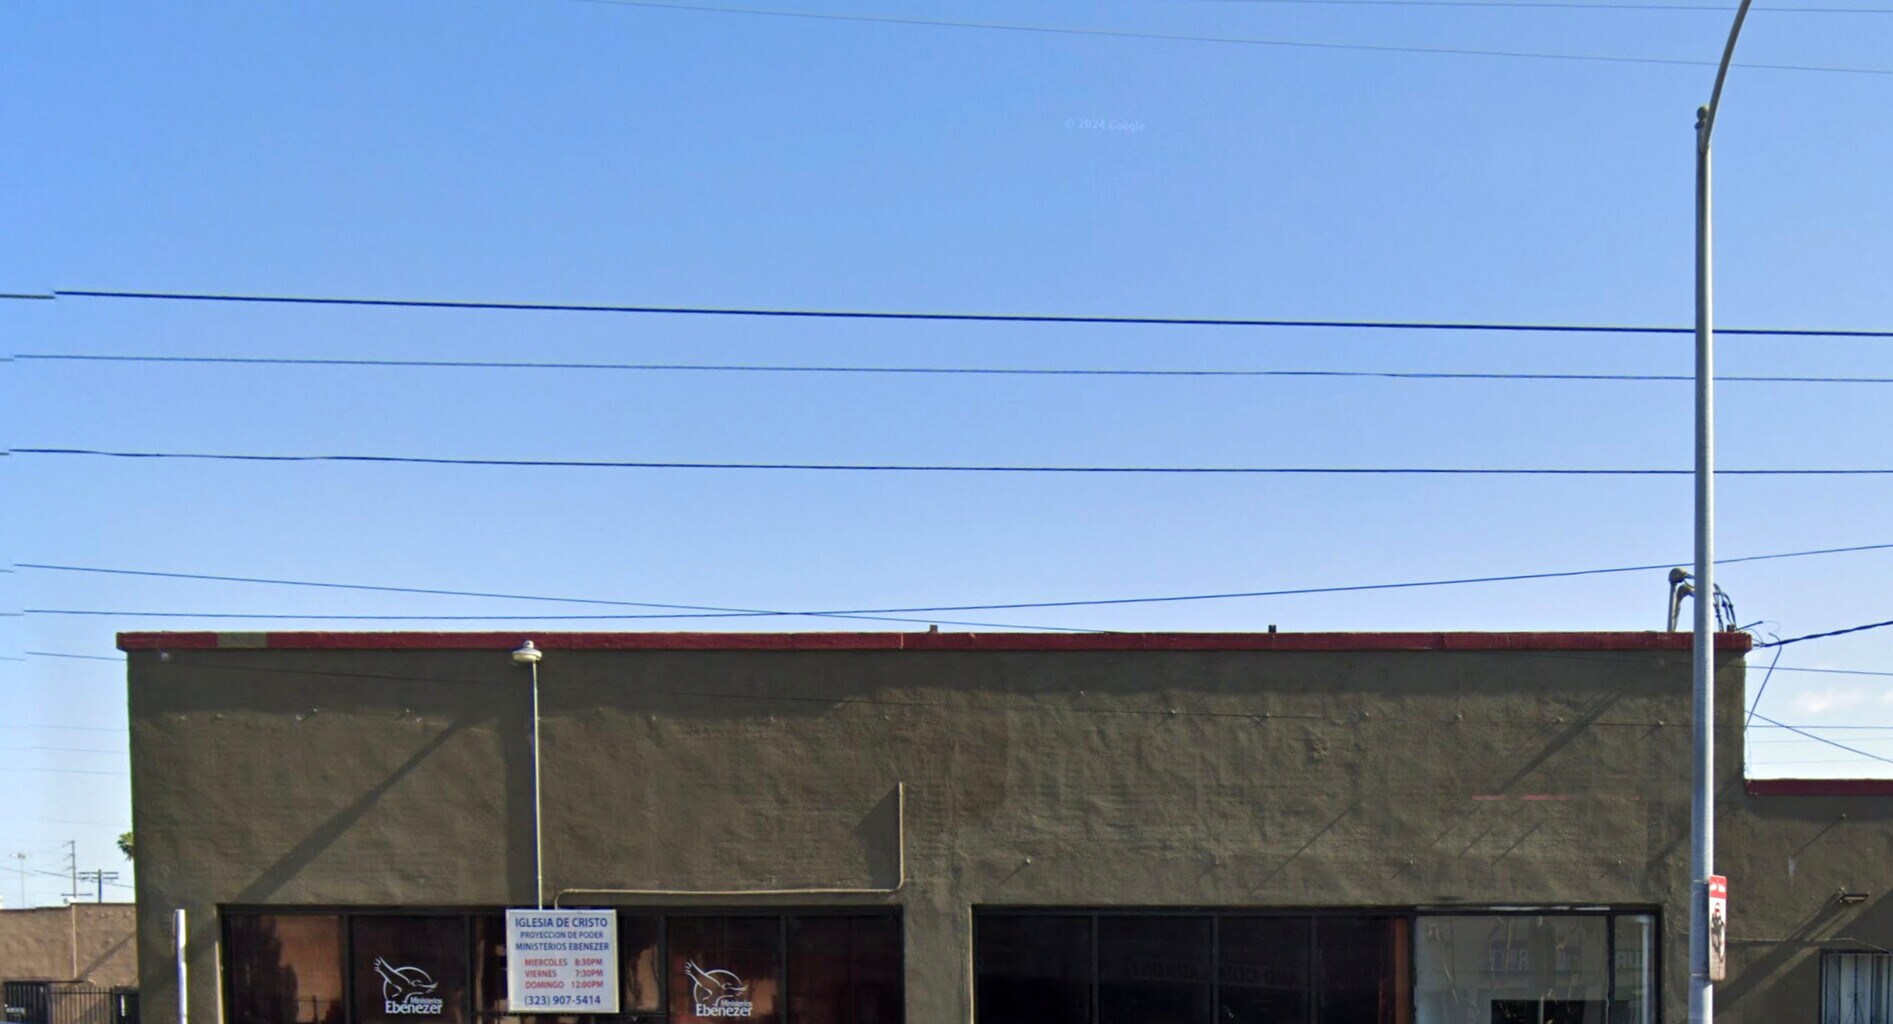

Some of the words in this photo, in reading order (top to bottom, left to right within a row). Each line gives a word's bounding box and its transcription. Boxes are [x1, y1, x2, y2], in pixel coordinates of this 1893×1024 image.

[515, 917, 554, 927] IGLESIA
[556, 918, 569, 927] DE
[572, 917, 608, 927] CRISTO
[520, 931, 566, 939] PROYECCION
[567, 931, 577, 939] DE
[579, 931, 603, 939] PODER
[515, 942, 567, 951] MINISTERIOS
[569, 942, 609, 950] EBENEZER
[524, 958, 568, 967] MIERCOLES
[525, 969, 557, 978] VIERNES
[575, 969, 603, 977] 7:30PM
[525, 981, 564, 989] DOMINGO
[524, 995, 550, 1006] (323)
[553, 995, 601, 1005] 907-5414
[385, 1000, 443, 1014] Ebenezer
[696, 1003, 753, 1016] Ebenezer
